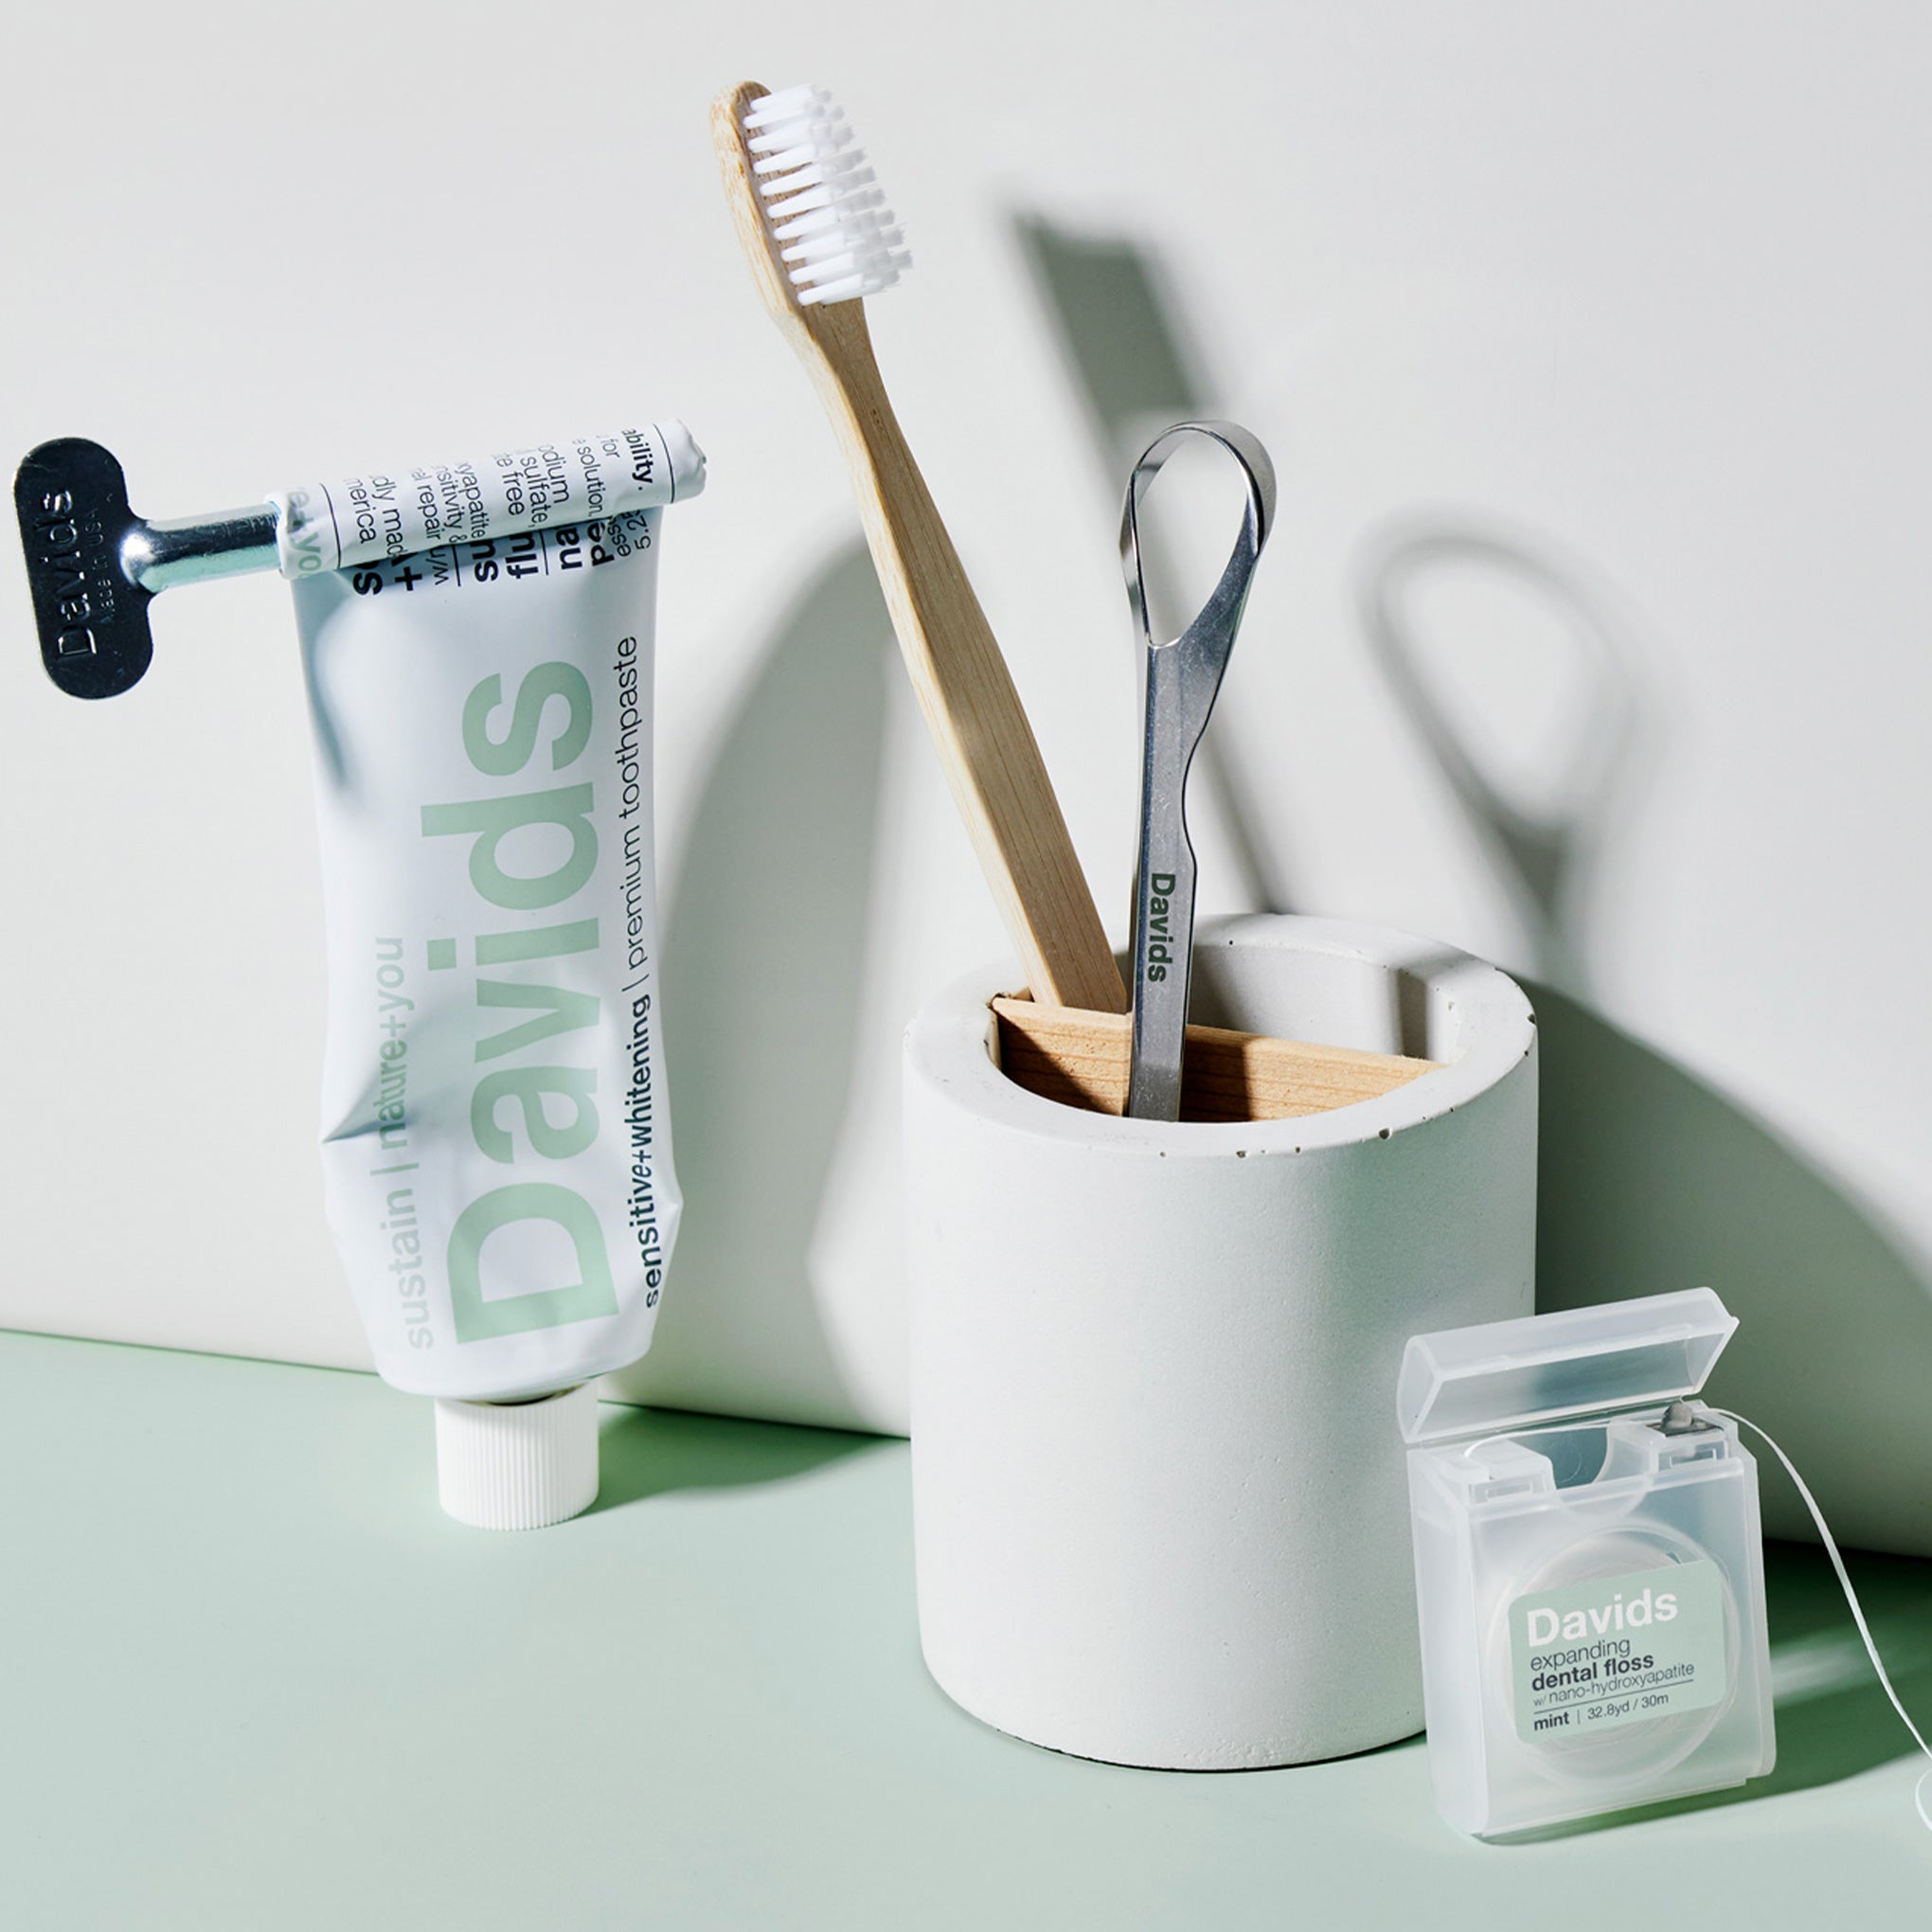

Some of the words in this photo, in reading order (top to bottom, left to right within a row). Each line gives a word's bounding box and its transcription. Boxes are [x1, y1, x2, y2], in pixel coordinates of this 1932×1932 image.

[600, 438, 620, 458] for
[417, 484, 446, 541] repair
[502, 472, 526, 515] free
[522, 456, 552, 528] sulfate,
[84, 509, 104, 546] USA
[448, 533, 468, 544] &
[32, 490, 97, 657] Davids
[614, 635, 642, 820] toothpaste
[619, 825, 650, 971] premium
[1148, 872, 1176, 983] Davids
[420, 661, 620, 1345] Davids
[373, 936, 415, 1152] nature+you
[623, 993, 662, 1309] sensitive+whitening
[387, 1187, 435, 1351] sustain
[1527, 1588, 1678, 1647] Davids
[1530, 1638, 1631, 1672] expanding
[1531, 1662, 1598, 1691] dental
[1603, 1654, 1655, 1677] floss
[1549, 1663, 1695, 1704] nano-hydroxyapatite
[1533, 1711, 1570, 1731] mint
[1587, 1699, 1630, 1721] 32.8yd
[1641, 1693, 1670, 1708] 30m
